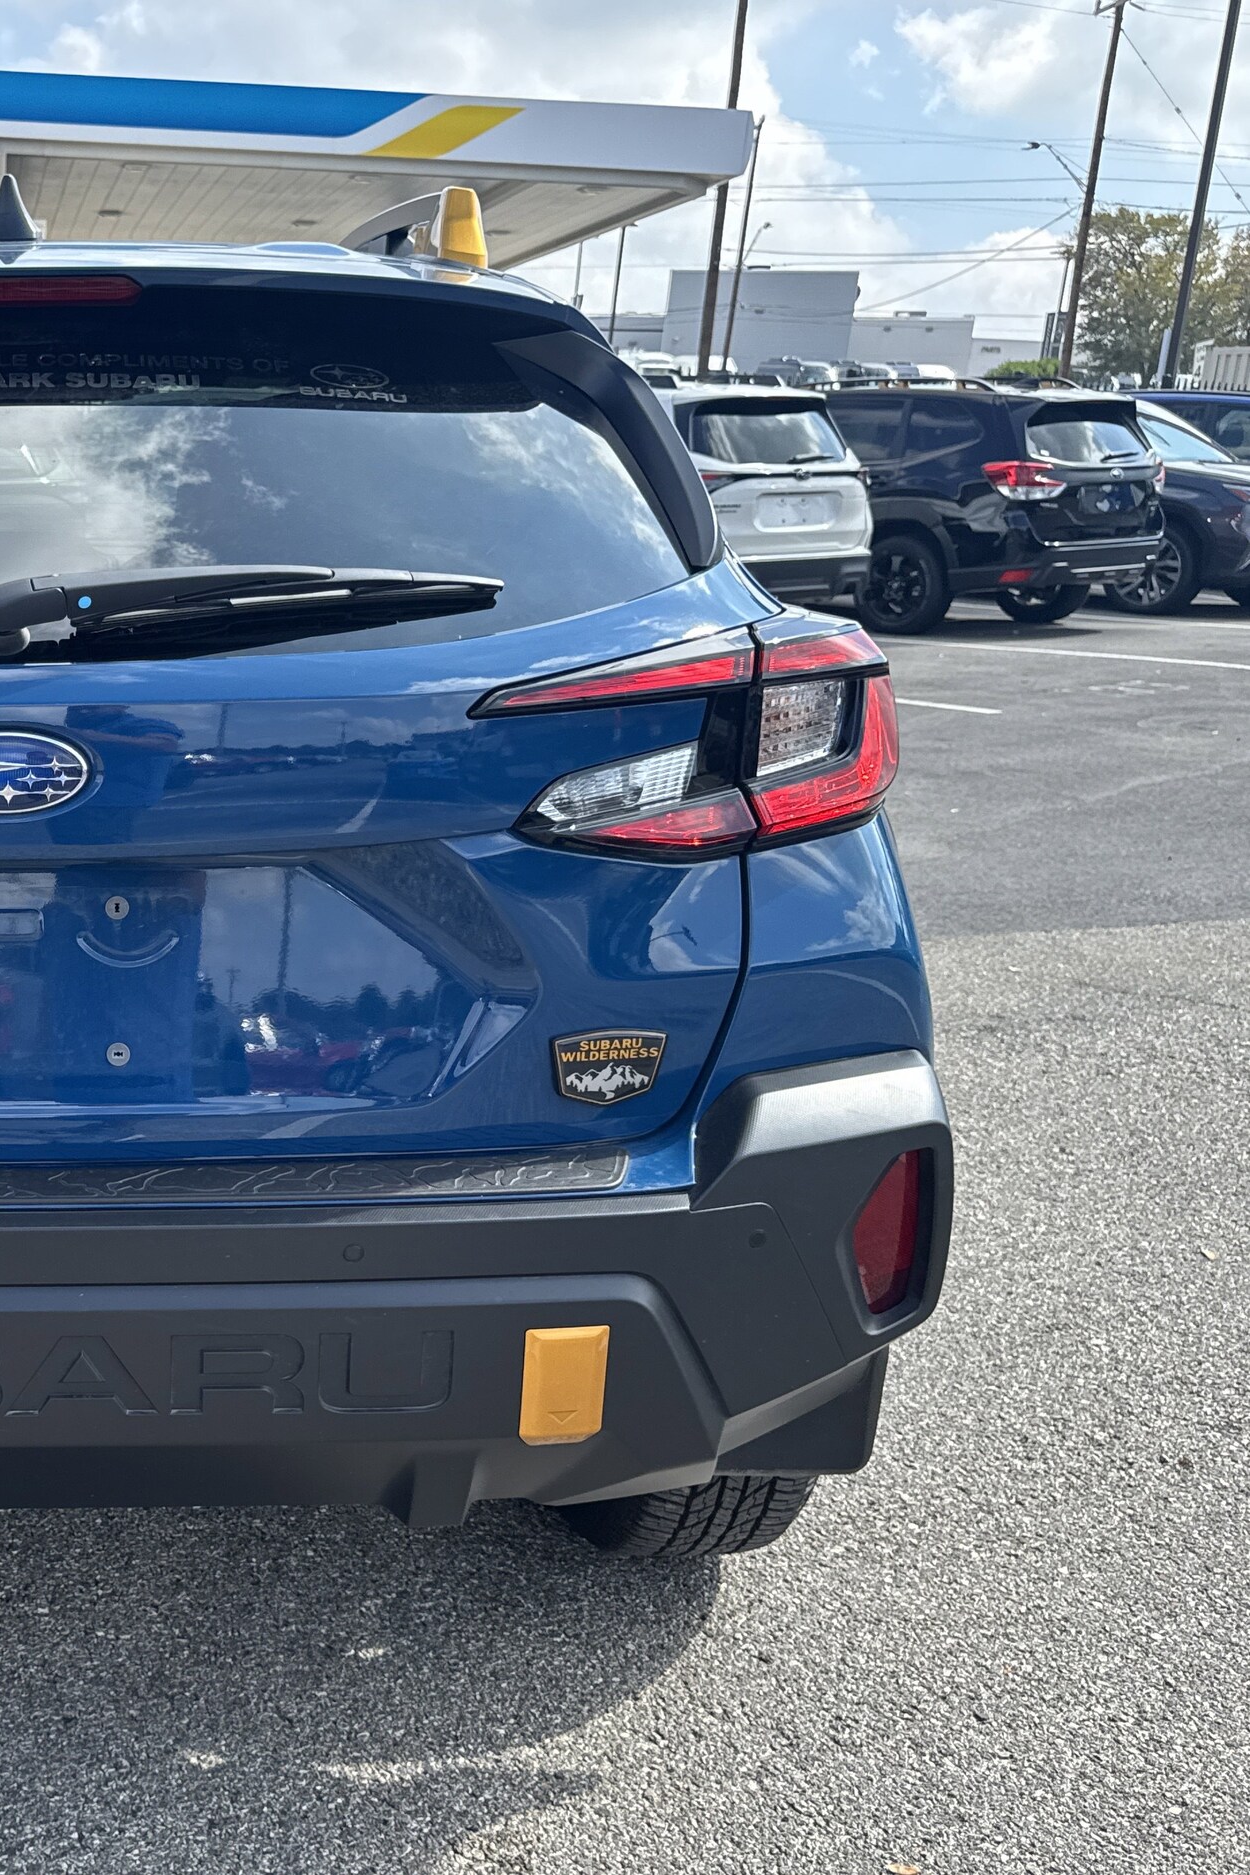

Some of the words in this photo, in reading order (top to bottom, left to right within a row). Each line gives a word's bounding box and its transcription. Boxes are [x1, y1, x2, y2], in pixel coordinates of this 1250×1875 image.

[37, 353, 245, 371] COMPLIMENTS
[252, 358, 291, 374] OF
[65, 372, 201, 393] SUBARU
[299, 386, 409, 404] SUBARU
[579, 1038, 643, 1052] SUBARU
[560, 1047, 660, 1063] WILDERNESS
